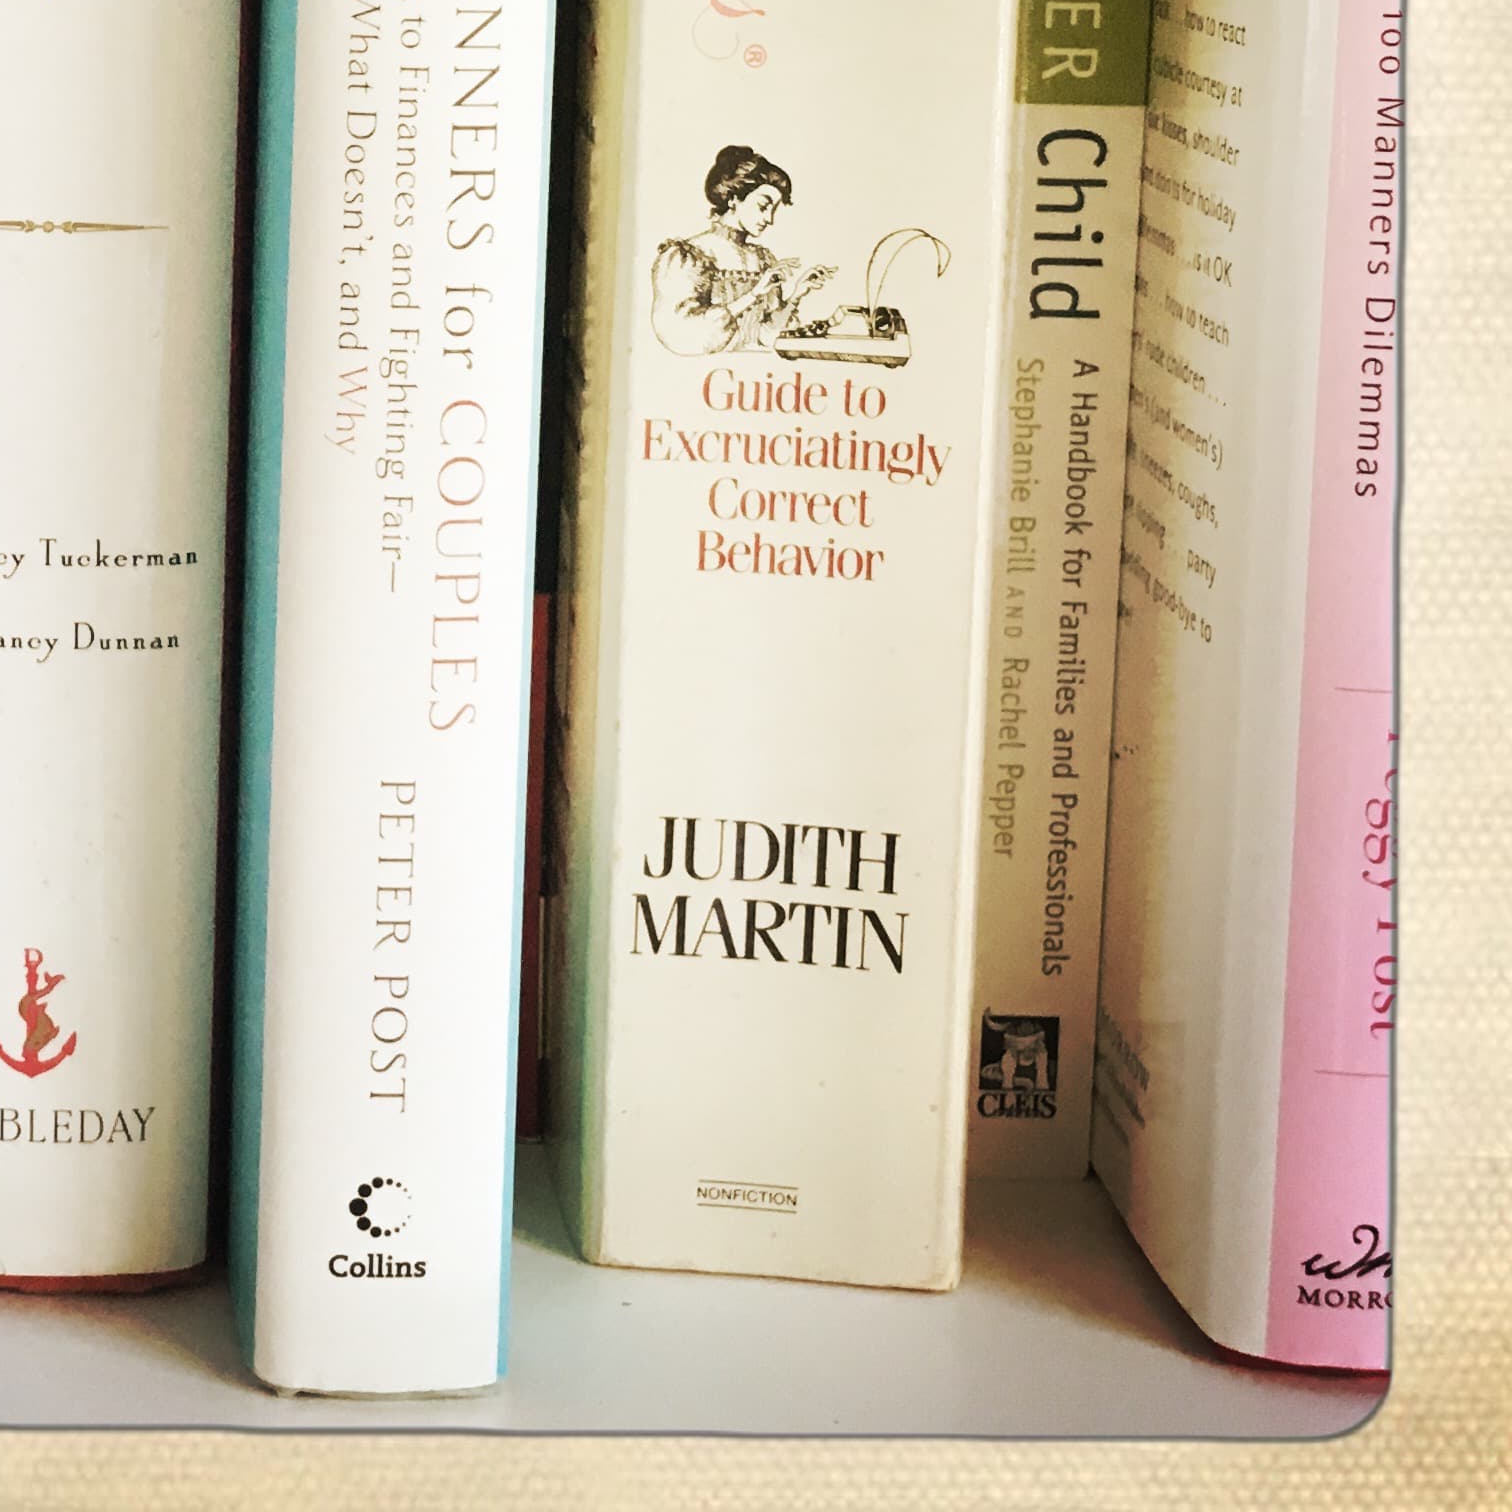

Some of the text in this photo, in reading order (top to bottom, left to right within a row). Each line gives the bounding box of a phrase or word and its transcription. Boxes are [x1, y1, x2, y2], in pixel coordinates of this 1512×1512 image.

[399, 14, 425, 50] to
[1217, 18, 1246, 48] react
[1230, 84, 1243, 108] at
[391, 66, 431, 228] Finances
[1192, 126, 1240, 167] shoulder
[335, 110, 379, 265] Doesn't,
[1196, 188, 1237, 233] holiday
[1366, 97, 1406, 277] Manners
[1028, 128, 1108, 319] Child
[389, 242, 422, 311] and
[1212, 255, 1233, 288] OK
[335, 280, 369, 352] and
[441, 284, 494, 370] for
[1198, 309, 1230, 348] teach
[324, 365, 369, 456] Why
[374, 327, 421, 480] Fighting
[701, 367, 888, 420] Guide to
[1353, 297, 1397, 498] Dilemmas
[642, 418, 952, 487] Excruciatingly
[1009, 357, 1046, 504] Stephanie
[707, 476, 875, 529] Correct
[1177, 480, 1219, 529] coughs,
[38, 537, 199, 569] Tuckerman
[427, 399, 489, 732] COUPLES
[696, 529, 885, 583] Behavior
[1006, 515, 1038, 576] Brill
[1187, 545, 1216, 589] party
[71, 622, 181, 652] Dunnan
[1199, 616, 1213, 644] to
[1041, 358, 1101, 978] A Handbook for Families and Professionals
[999, 657, 1031, 750] Rachel
[988, 763, 1025, 860] Pepper
[641, 815, 902, 895] JUDITH
[368, 779, 418, 1114] PETER POST
[629, 892, 910, 975] MARTIN
[696, 1186, 799, 1208] NONFICTION
[328, 1253, 428, 1279] Collins
